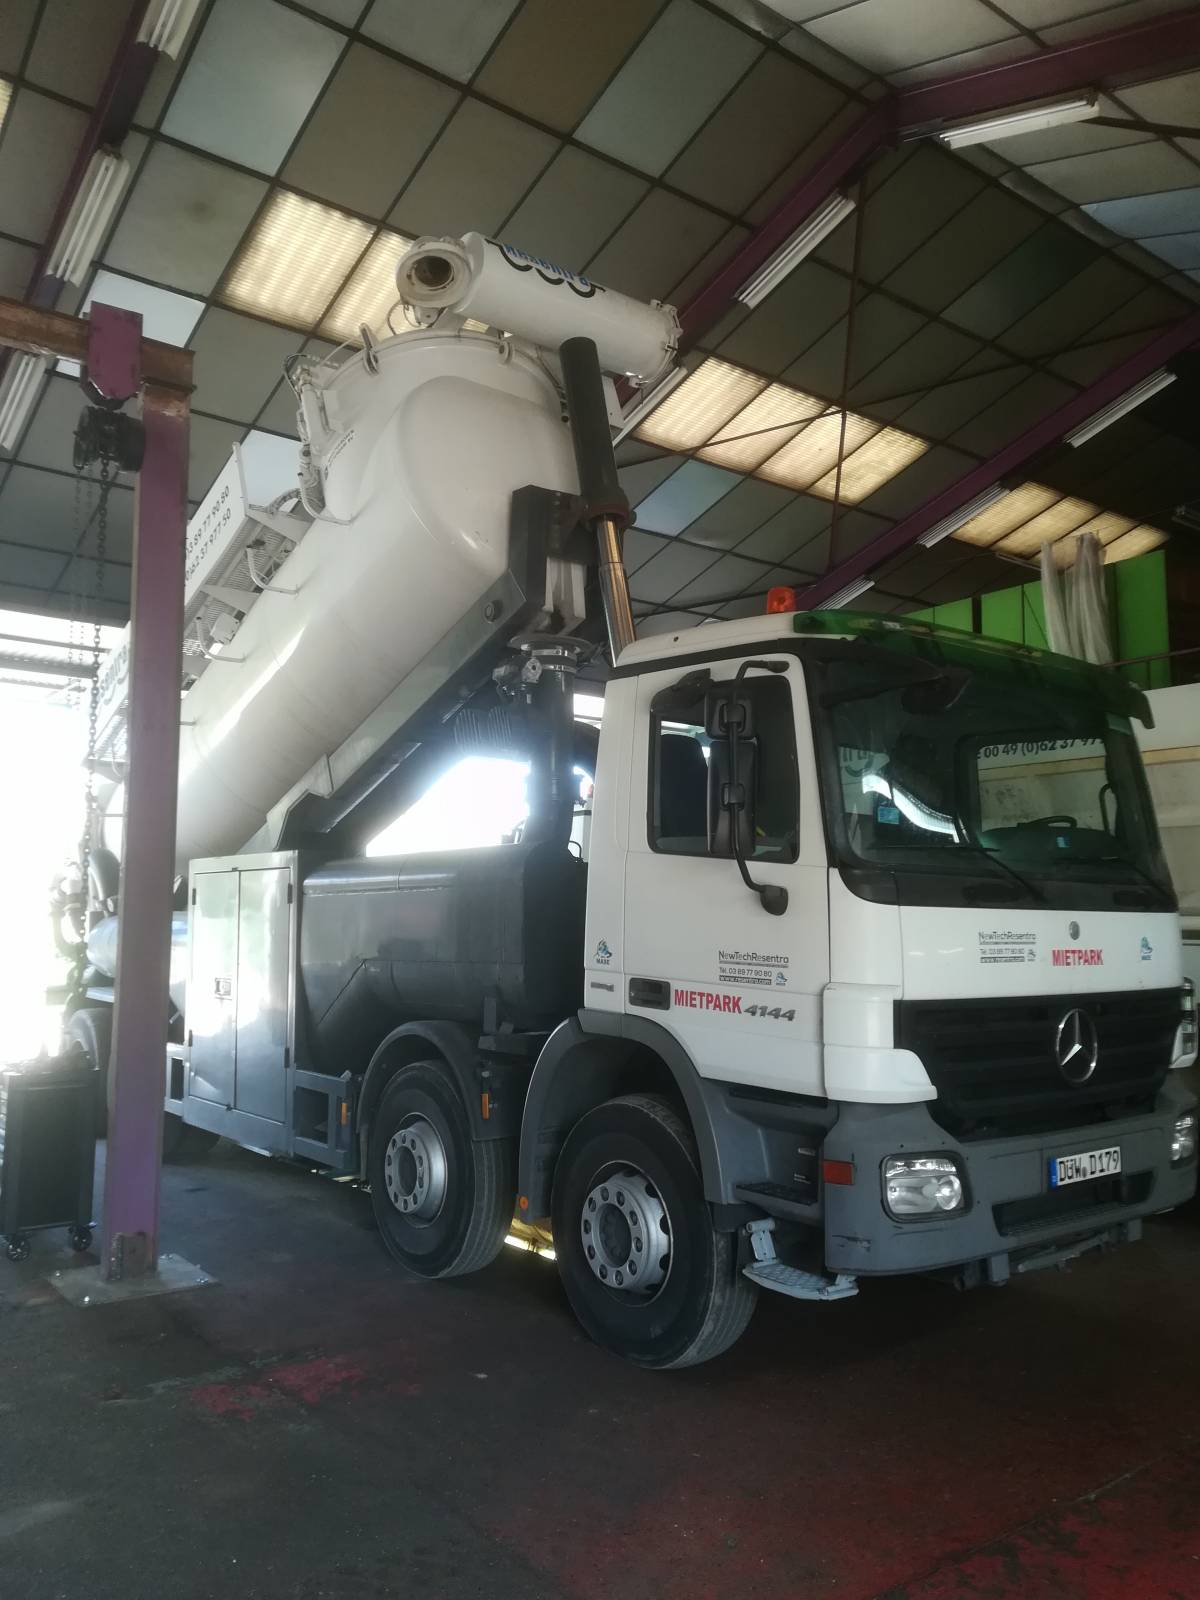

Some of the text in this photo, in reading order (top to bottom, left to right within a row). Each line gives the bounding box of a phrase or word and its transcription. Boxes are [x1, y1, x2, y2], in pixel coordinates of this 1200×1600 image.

[1052, 949, 1104, 967] MIETPARK
[674, 989, 742, 1014] MIETPARK
[744, 1004, 796, 1022] 4144
